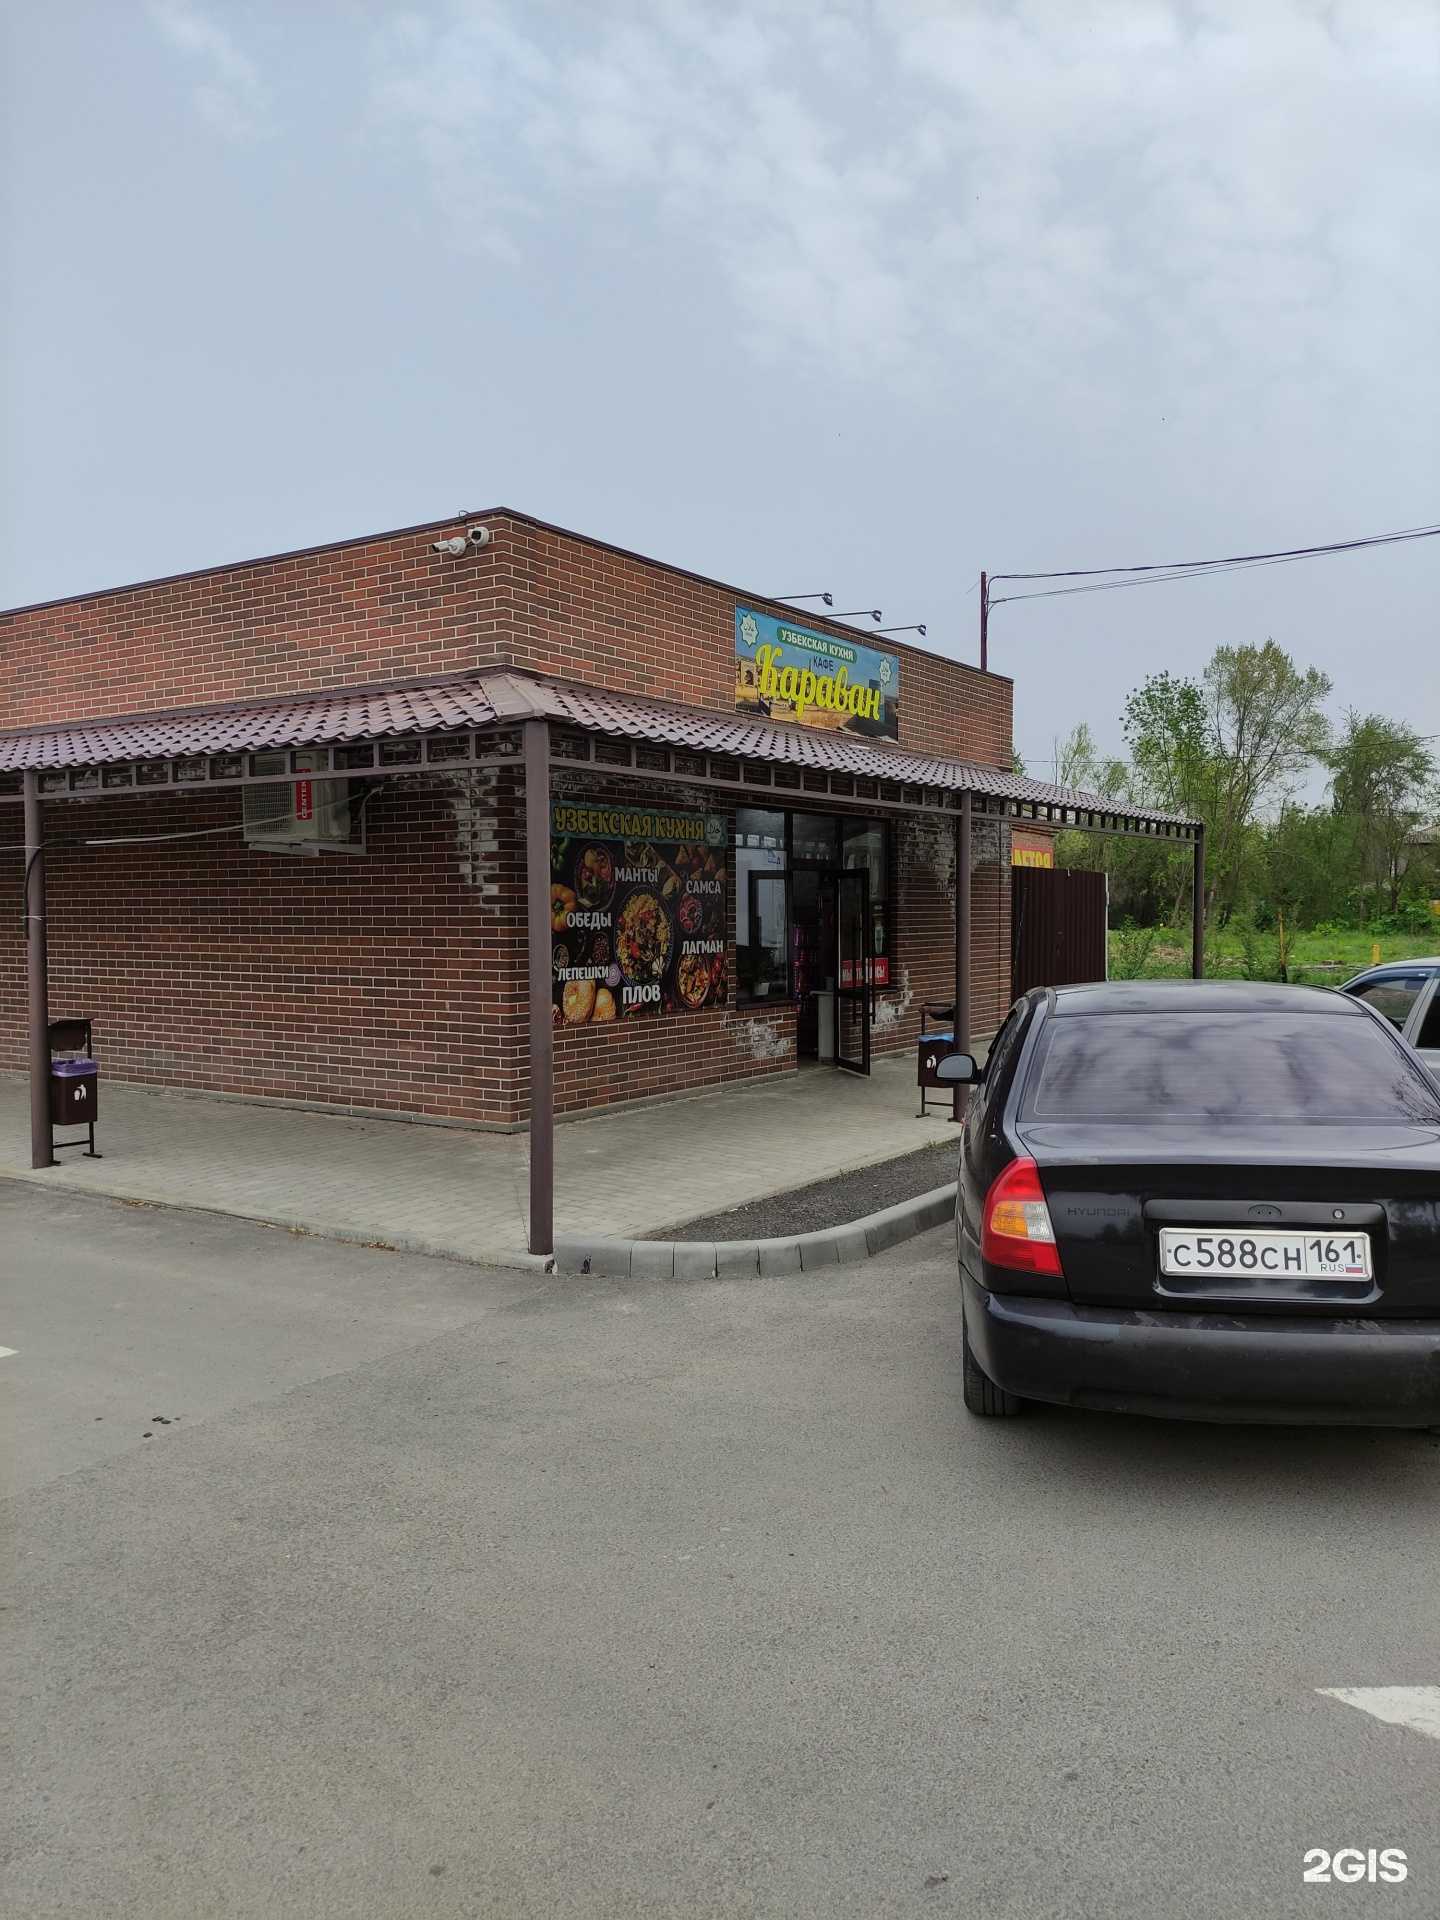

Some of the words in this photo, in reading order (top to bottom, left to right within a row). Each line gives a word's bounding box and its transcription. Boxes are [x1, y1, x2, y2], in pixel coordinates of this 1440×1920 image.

[781, 629, 828, 653] УЗБЕКСКАЯ
[829, 643, 854, 661] КУХНЯ
[813, 656, 834, 672] КАФЕ
[755, 644, 880, 720] Караван
[554, 807, 654, 838] УЗБЕКСКАЯ
[655, 816, 705, 841] КУХНЯ
[615, 867, 659, 883] МАНТЫ
[686, 880, 722, 894] САМСА
[566, 912, 612, 930] ОБЕДЫ
[682, 940, 724, 955] ЛАГМАН
[558, 965, 609, 982] ЛЕПЕШКИ
[623, 985, 661, 1004] ПЛОВ
[1066, 1207, 1130, 1217] HYUNDAI
[1309, 1239, 1356, 1263] 161
[1320, 1263, 1345, 1273] RUS
